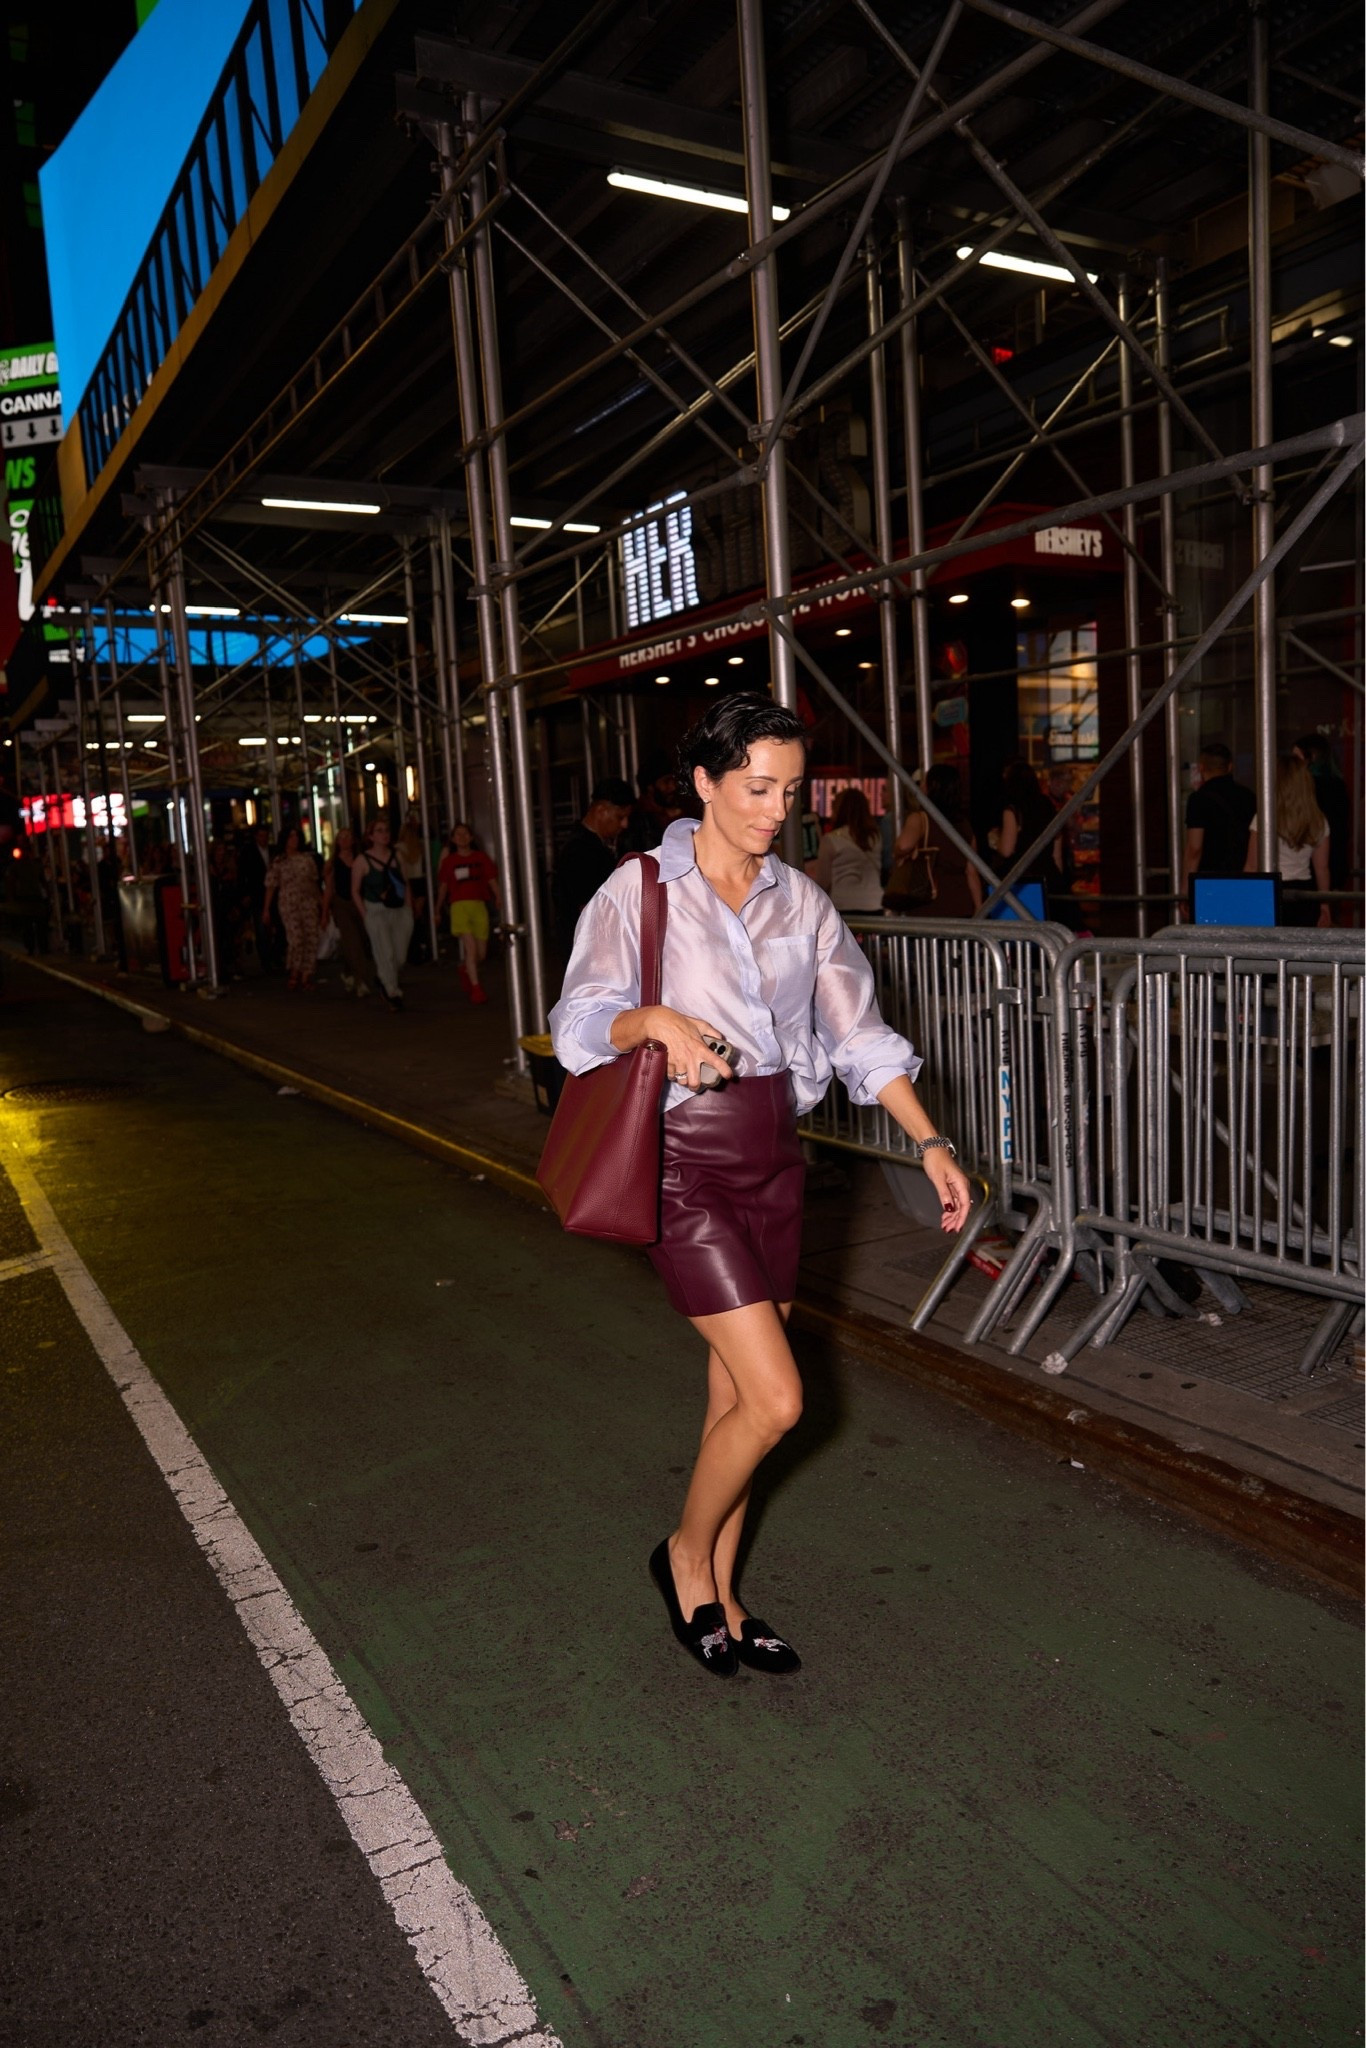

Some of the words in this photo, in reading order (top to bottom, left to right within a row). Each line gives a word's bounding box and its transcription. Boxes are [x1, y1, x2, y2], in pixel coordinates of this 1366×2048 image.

[1034, 526, 1104, 558] HERSHEY'S
[619, 635, 697, 669] HERSHEYS
[1001, 1070, 1012, 1160] NYPD
